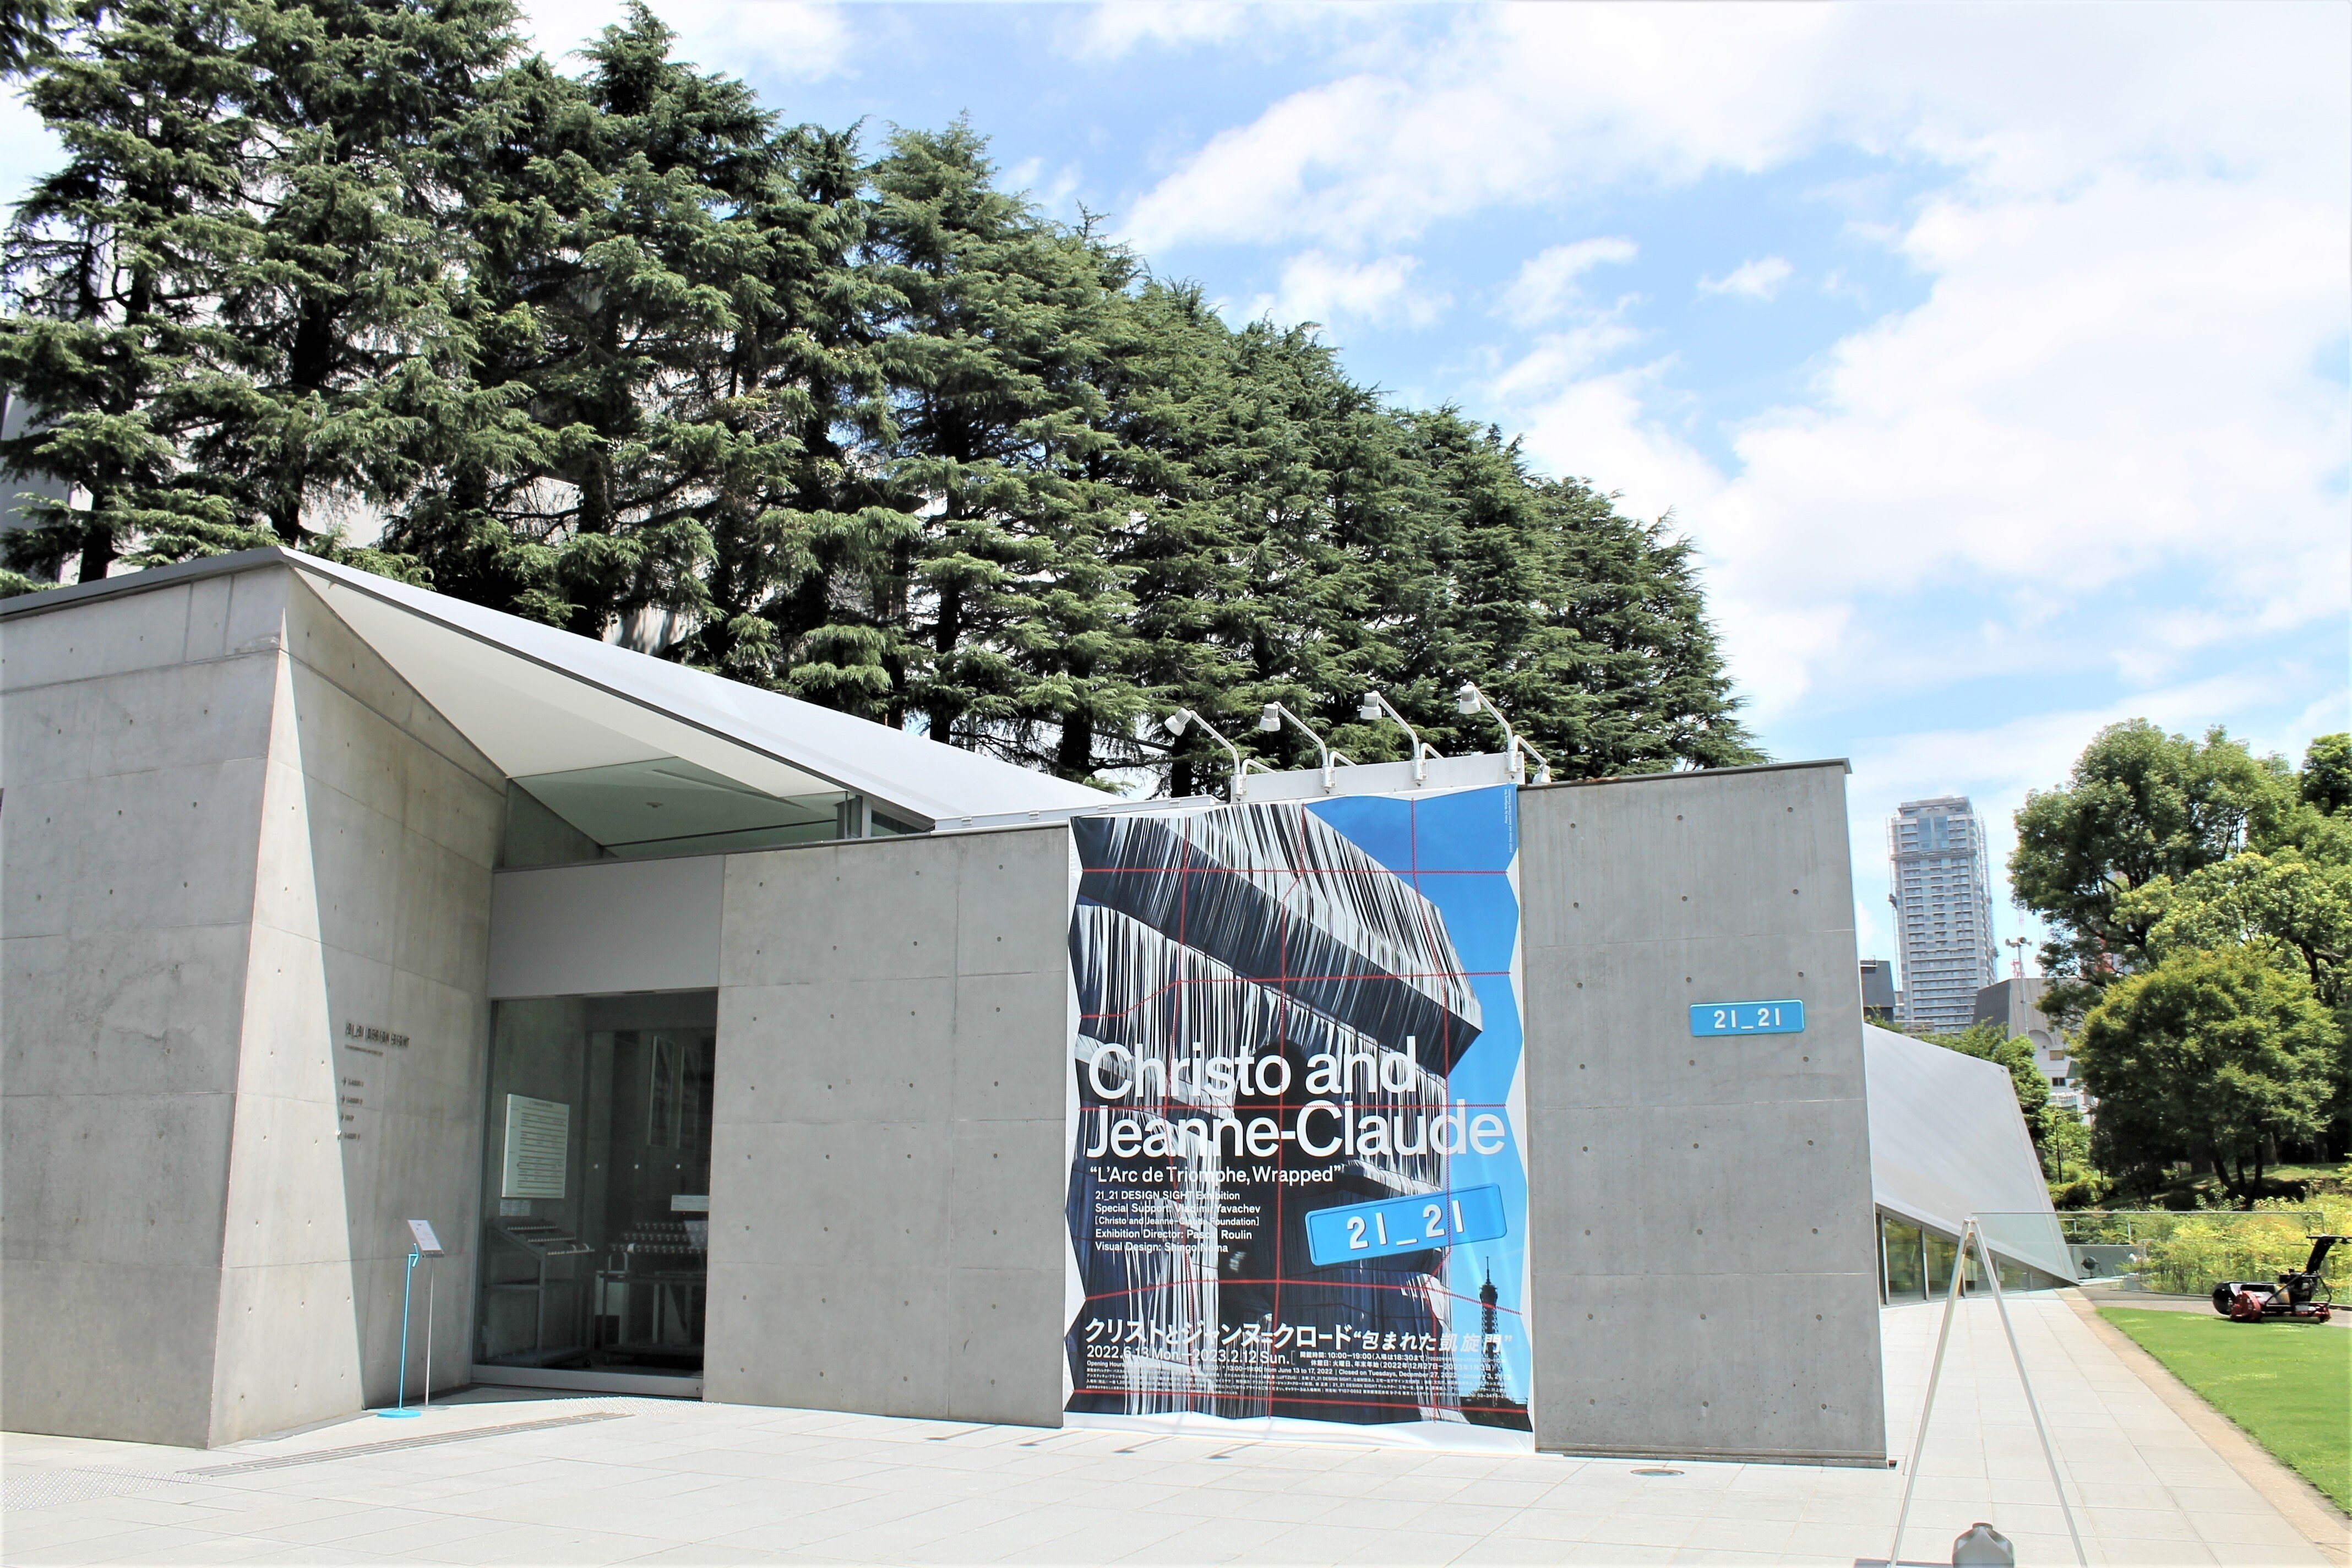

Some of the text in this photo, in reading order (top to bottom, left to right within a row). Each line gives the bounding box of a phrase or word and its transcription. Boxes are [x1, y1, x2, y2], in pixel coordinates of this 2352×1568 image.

[1713, 1008, 1781, 1030] 21_21
[1088, 1035, 1417, 1099] Christo and
[1086, 1098, 1505, 1159] Jeanne-Claude
[1142, 1166, 1164, 1183] de
[1166, 1166, 1251, 1186] Triomphe,
[1252, 1166, 1342, 1186] Wrapped”
[1095, 1190, 1240, 1201] 21_21 DESIGN SIGHT Exhibition
[1095, 1202, 1261, 1215] Special Support: Vladimir Yavachev
[1129, 1216, 1144, 1226] and
[1145, 1216, 1208, 1226] Jeanne-Claude
[1347, 1200, 1464, 1250] 21_21
[1095, 1228, 1253, 1240] Exhibition Director: Pasca Roulin
[1095, 1241, 1229, 1255] Visual Design: Shingo Noma
[1086, 1344, 1150, 1359] 2022.6.13
[1260, 1351, 1291, 1365] Sun.
[1086, 1360, 1108, 1368] Opening
[1368, 1369, 1398, 1378] Tuesdays,
